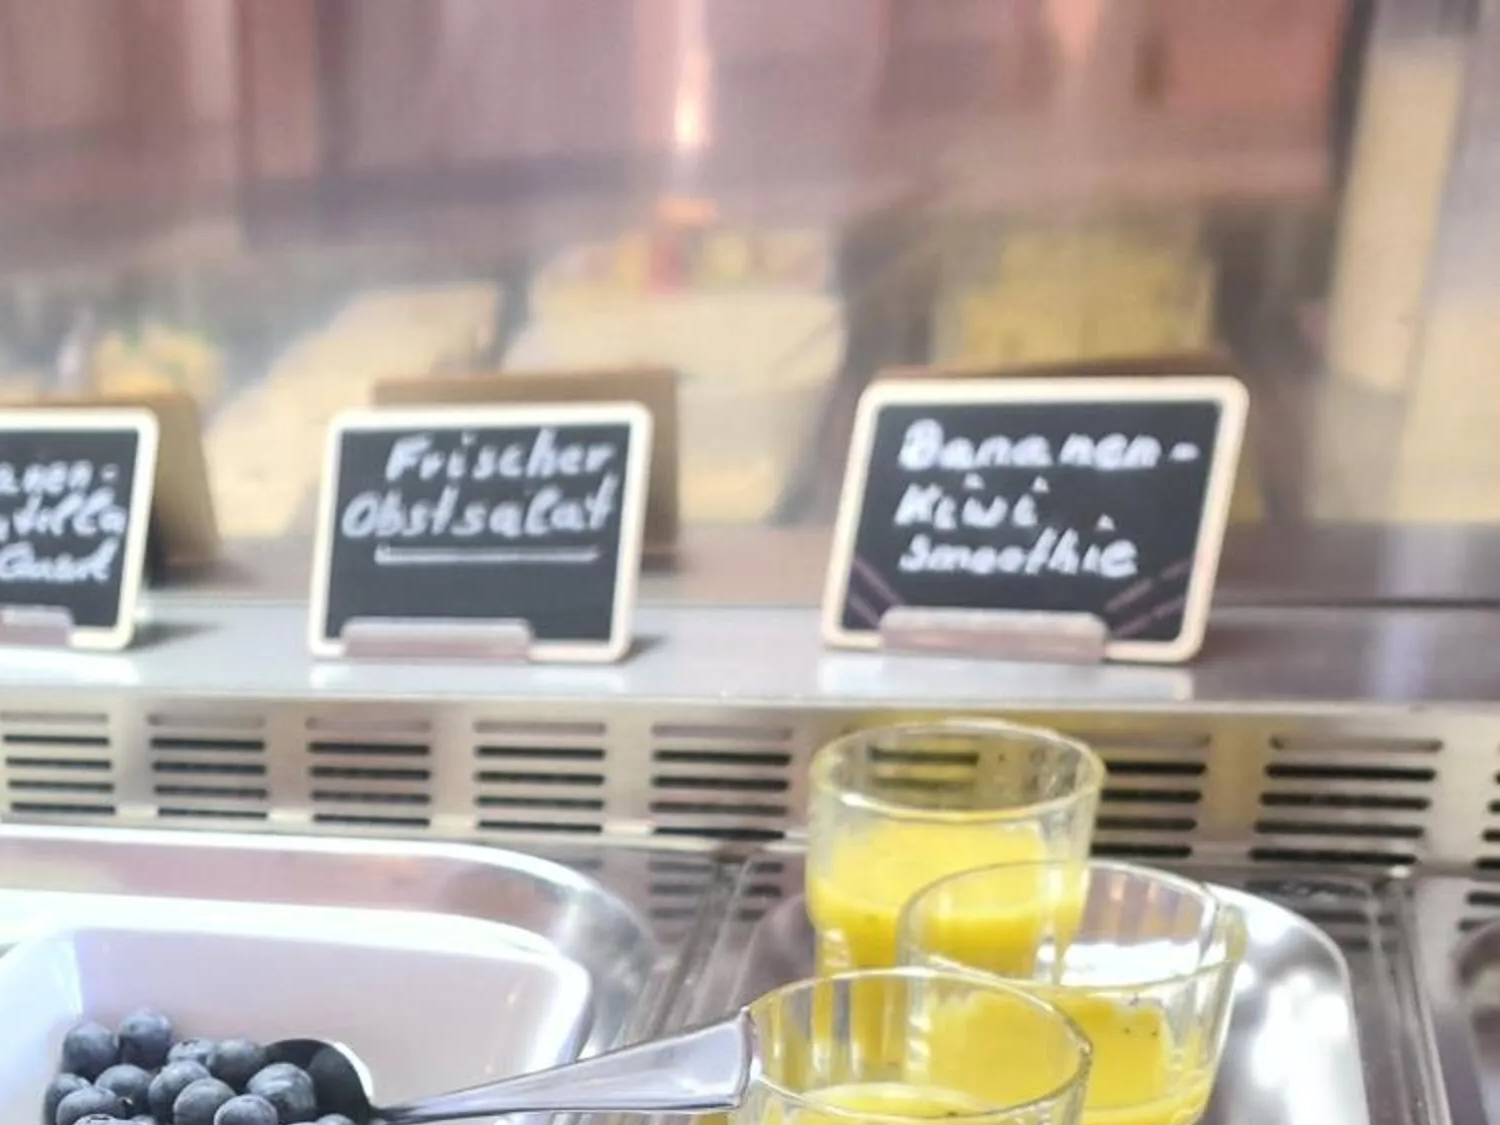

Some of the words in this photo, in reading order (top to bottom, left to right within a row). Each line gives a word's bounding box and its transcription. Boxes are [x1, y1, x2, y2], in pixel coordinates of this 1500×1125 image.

[384, 427, 618, 482] Frischer
[897, 417, 1200, 471] Bananen-
[341, 473, 619, 538] Obstsalat
[894, 472, 1049, 530] Kiwi
[897, 513, 1138, 578] Smoothie
